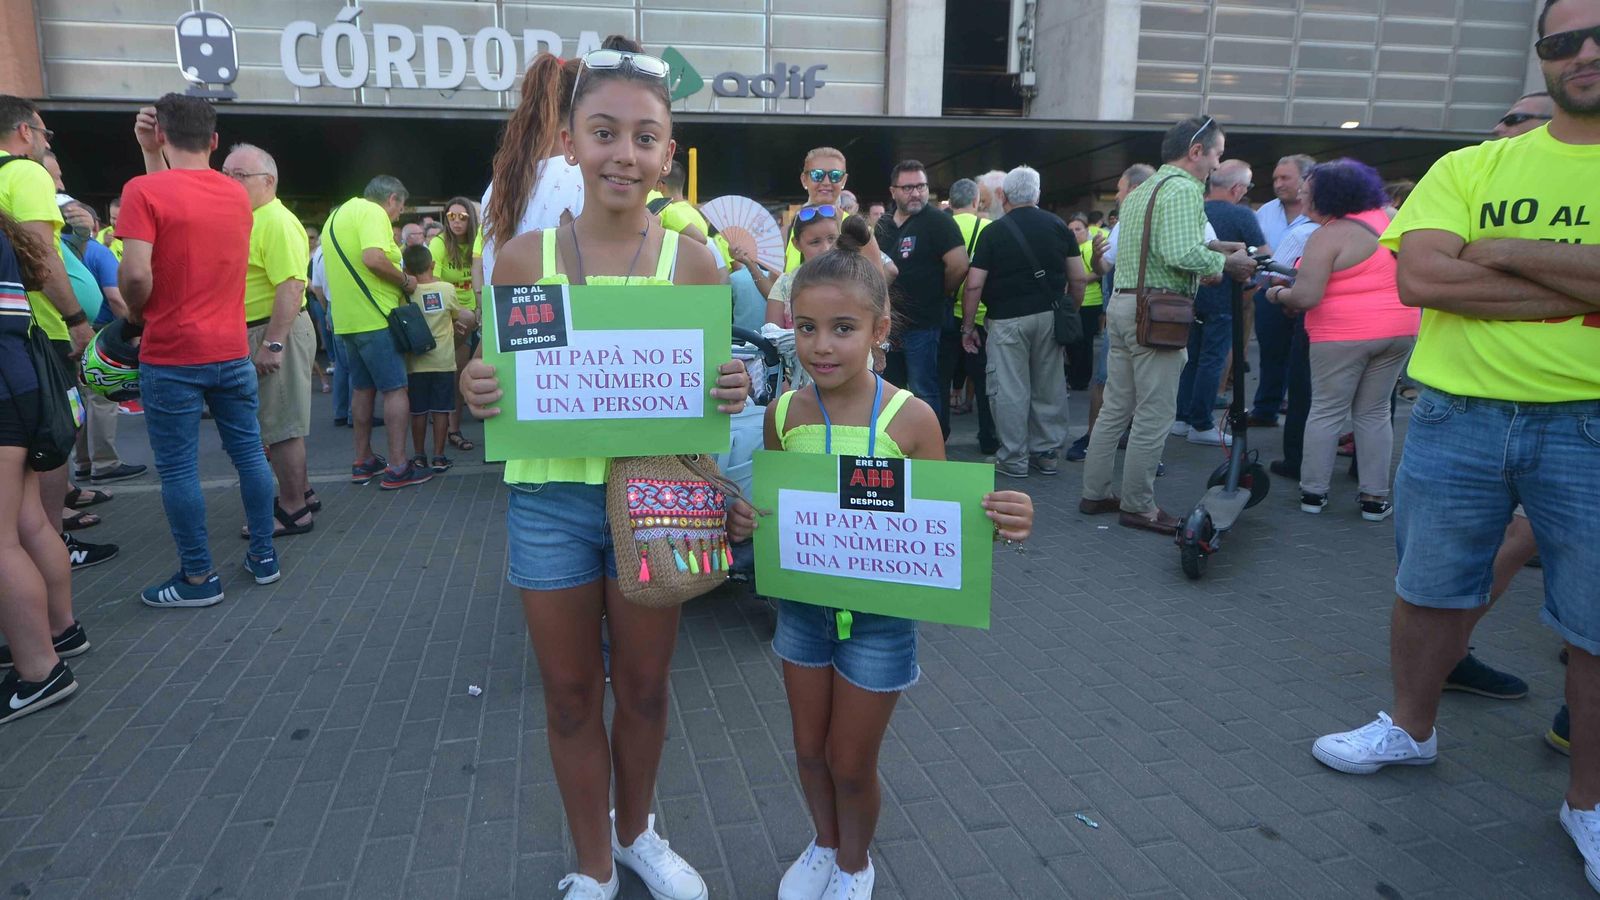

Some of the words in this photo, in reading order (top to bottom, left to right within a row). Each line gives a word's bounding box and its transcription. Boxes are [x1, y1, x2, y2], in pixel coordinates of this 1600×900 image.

[712, 62, 828, 100] adif
[1480, 198, 1539, 229] NO
[1548, 205, 1591, 227] AL
[512, 295, 531, 304] ERE
[533, 294, 546, 302] DE
[513, 287, 528, 295] NO
[507, 303, 555, 327] ABB
[510, 335, 556, 346] DESPIDOS
[536, 350, 561, 366] MI
[569, 345, 624, 366] PAPÀ
[632, 349, 665, 365] NO
[672, 348, 693, 365] ES
[536, 374, 569, 390] UN
[577, 369, 673, 390] NÙMERO
[680, 372, 701, 388] ES
[536, 397, 585, 413] UNA
[593, 395, 689, 412] PERSONA
[855, 459, 873, 467] ERE
[849, 468, 895, 488] ABB
[850, 498, 894, 507] DESPIDOS
[866, 490, 877, 498] 59
[795, 510, 818, 526] MI
[825, 511, 878, 531] PAPÀ
[885, 517, 918, 533] NO
[925, 519, 947, 535] ES
[795, 532, 825, 547] UN
[833, 532, 926, 555] NÙMERO
[934, 542, 956, 558] ES
[796, 551, 840, 569] UNA
[848, 555, 943, 578] PERSONA
